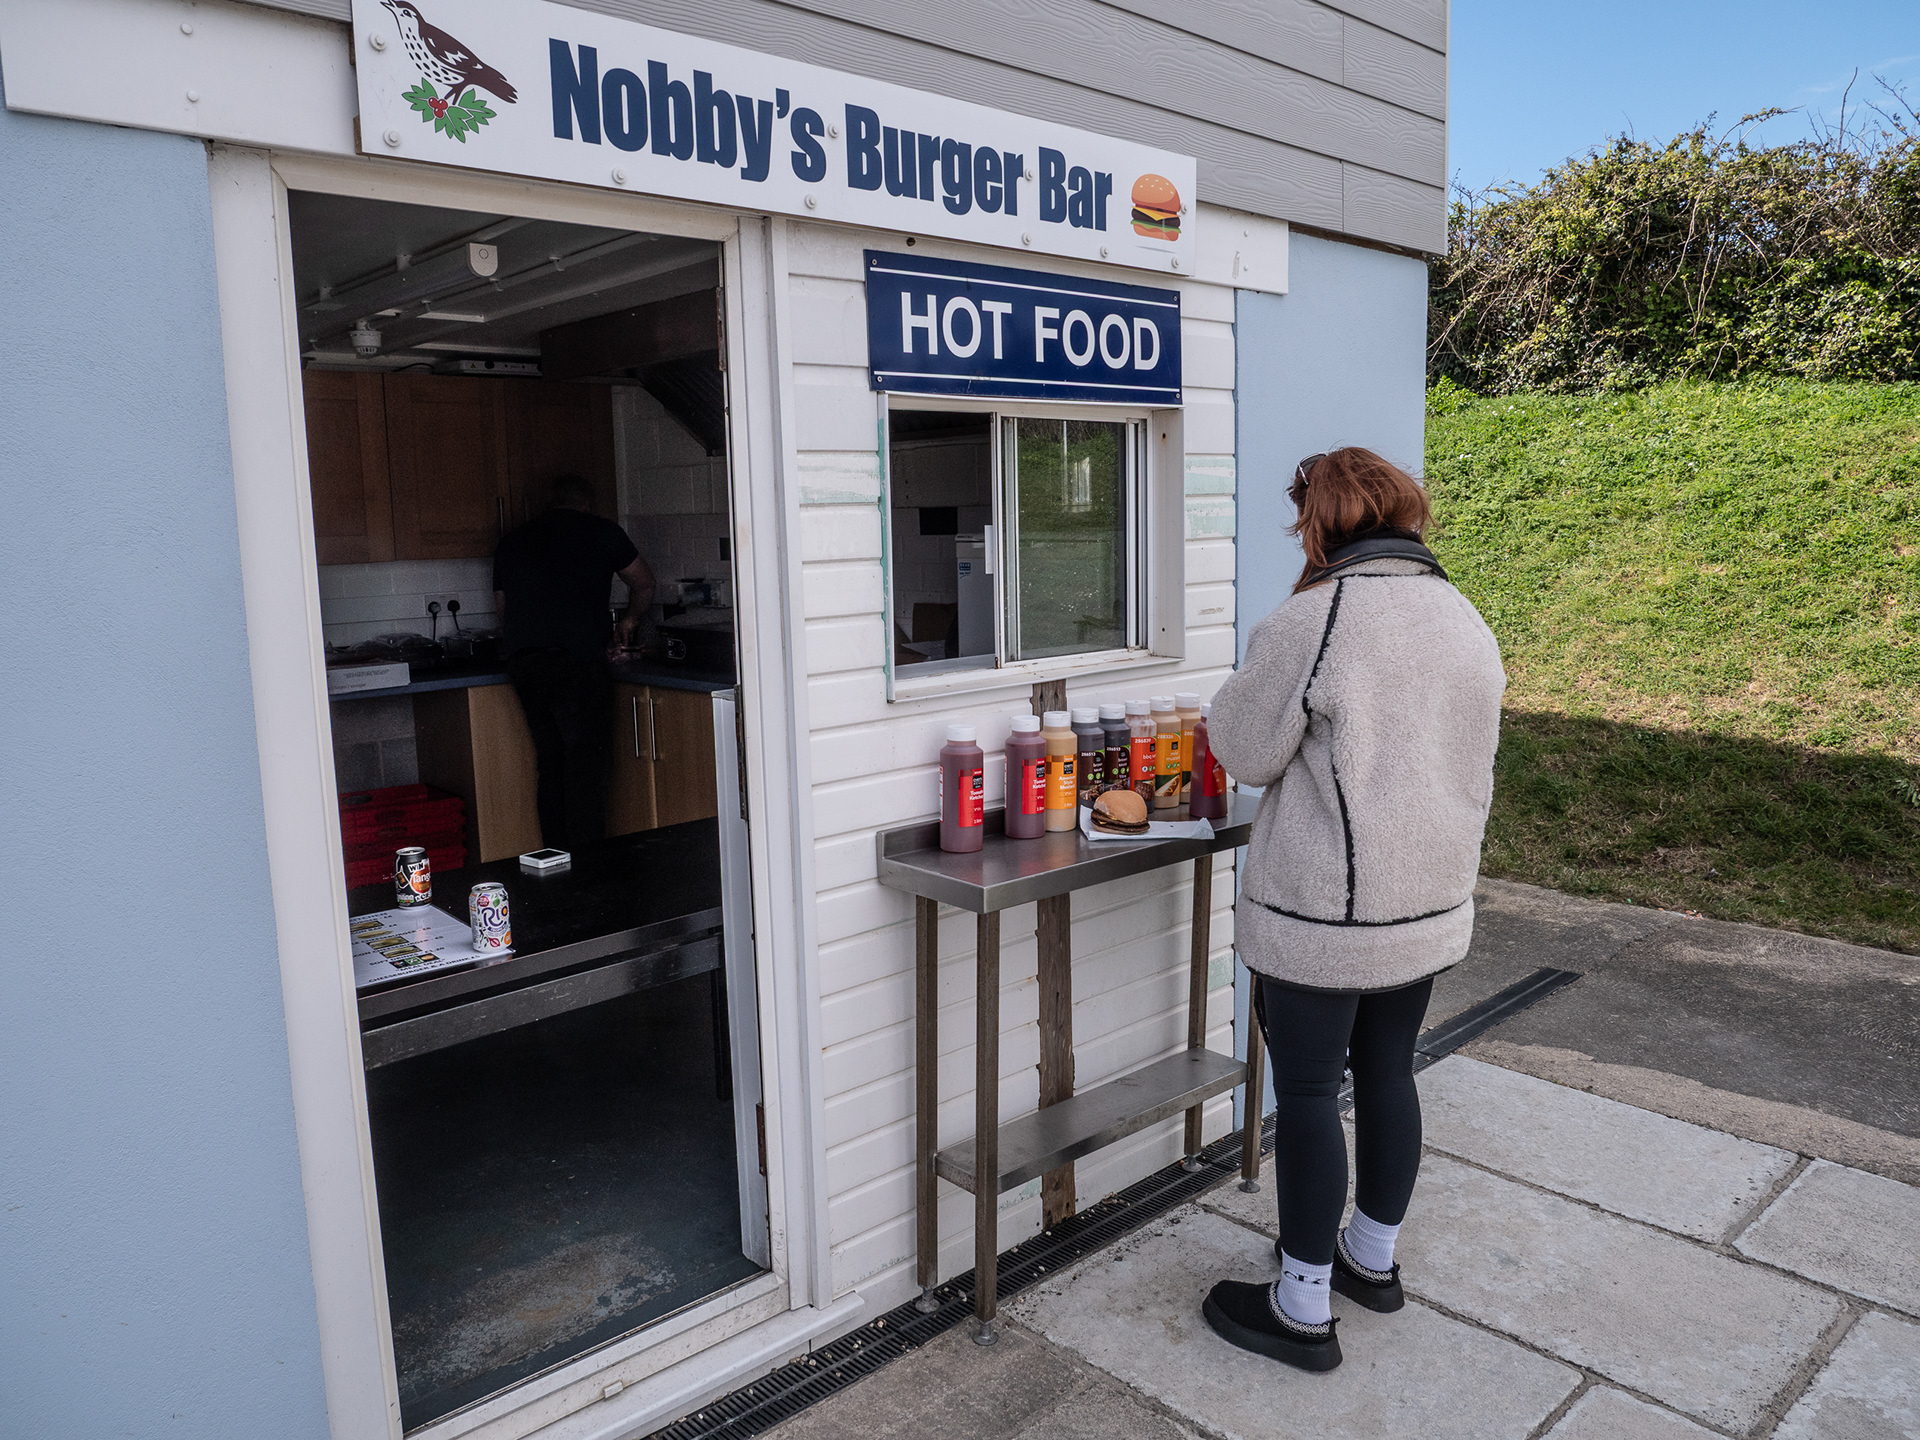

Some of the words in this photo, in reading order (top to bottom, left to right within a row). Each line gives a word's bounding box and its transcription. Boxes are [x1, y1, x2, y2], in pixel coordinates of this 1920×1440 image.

[549, 38, 827, 183] Nobby’s
[845, 103, 1024, 216] Burger
[1038, 146, 1112, 231] Bar
[901, 292, 1012, 360] HOT
[1035, 306, 1160, 370] FOOD
[409, 862, 424, 871] WIN
[411, 872, 431, 883] Tang
[482, 907, 508, 927] RIO
[361, 930, 417, 943] CHEESEBURGER
[373, 939, 430, 953] CHEESEBURGER
[369, 966, 429, 982] CHEESEBURGER
